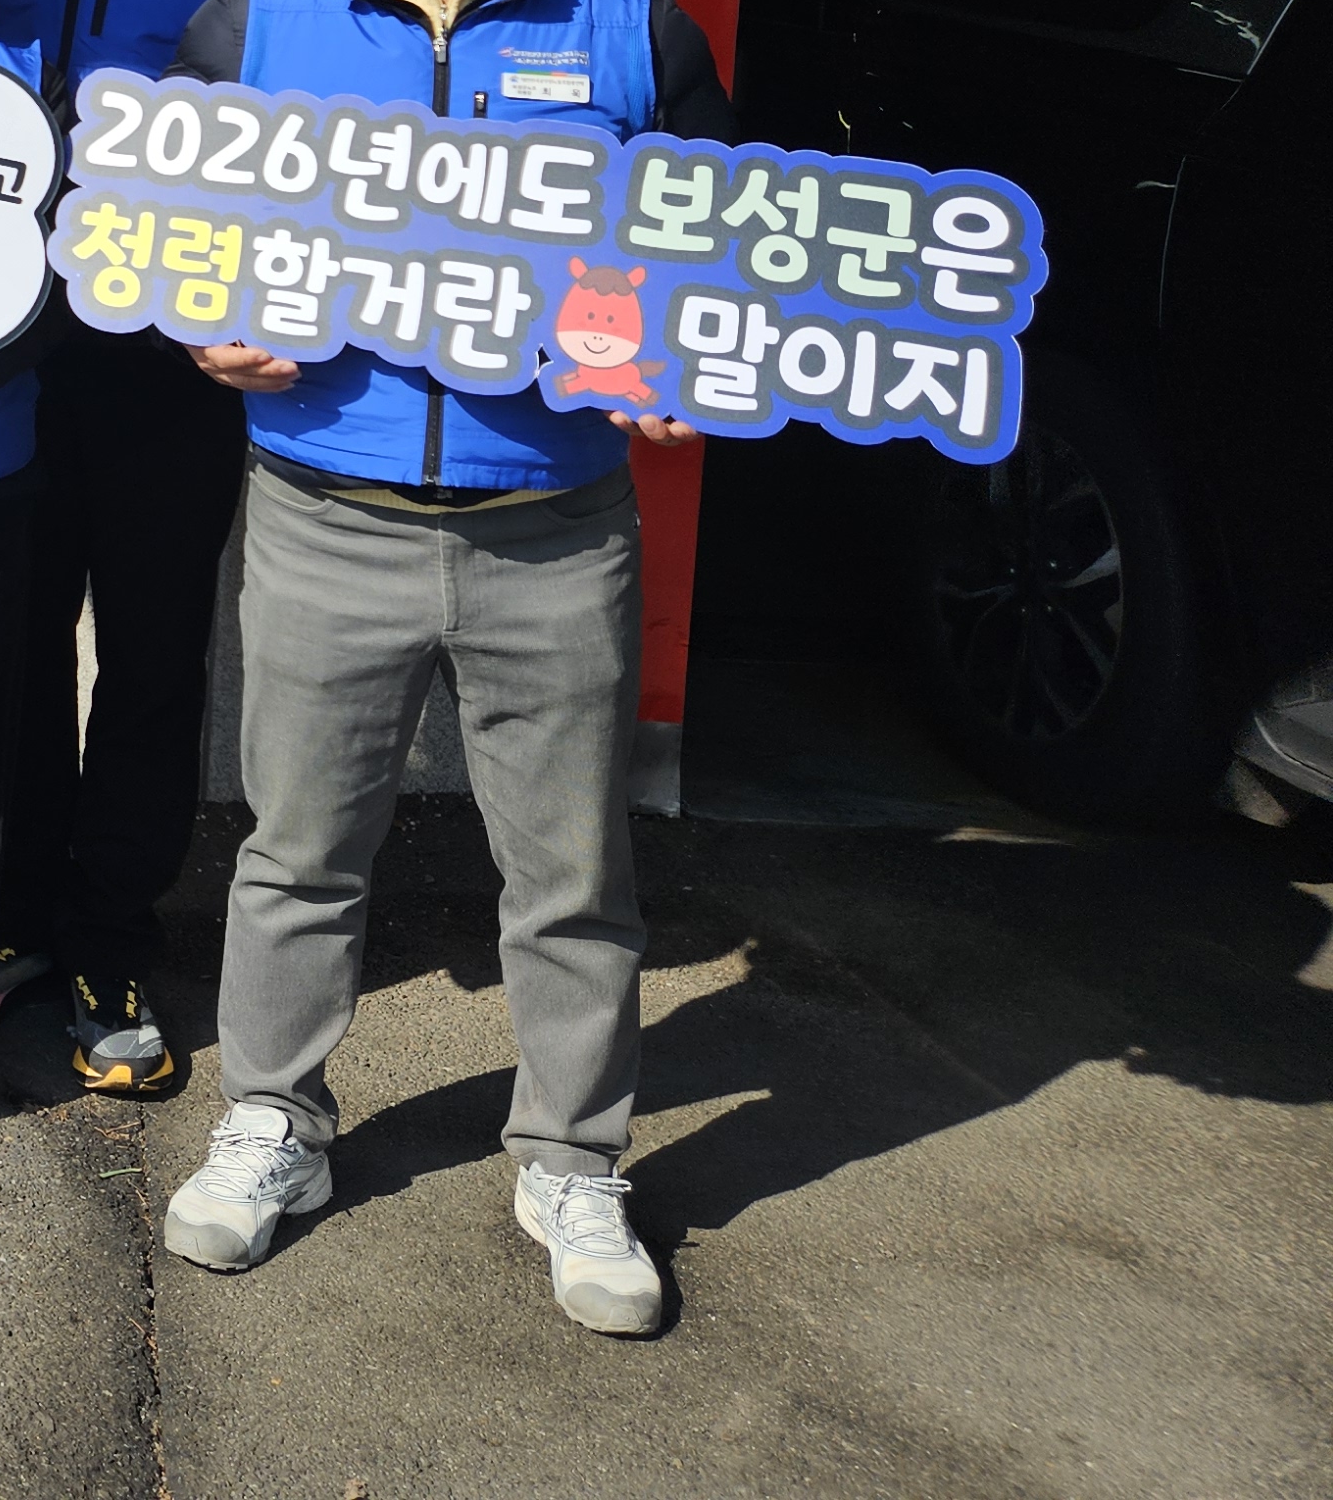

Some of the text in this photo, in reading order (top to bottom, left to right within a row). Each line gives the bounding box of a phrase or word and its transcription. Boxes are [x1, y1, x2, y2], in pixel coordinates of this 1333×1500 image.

[85, 90, 1015, 312] 2026년에도 보성군은
[72, 202, 988, 436] 청렴할거란 말이지
